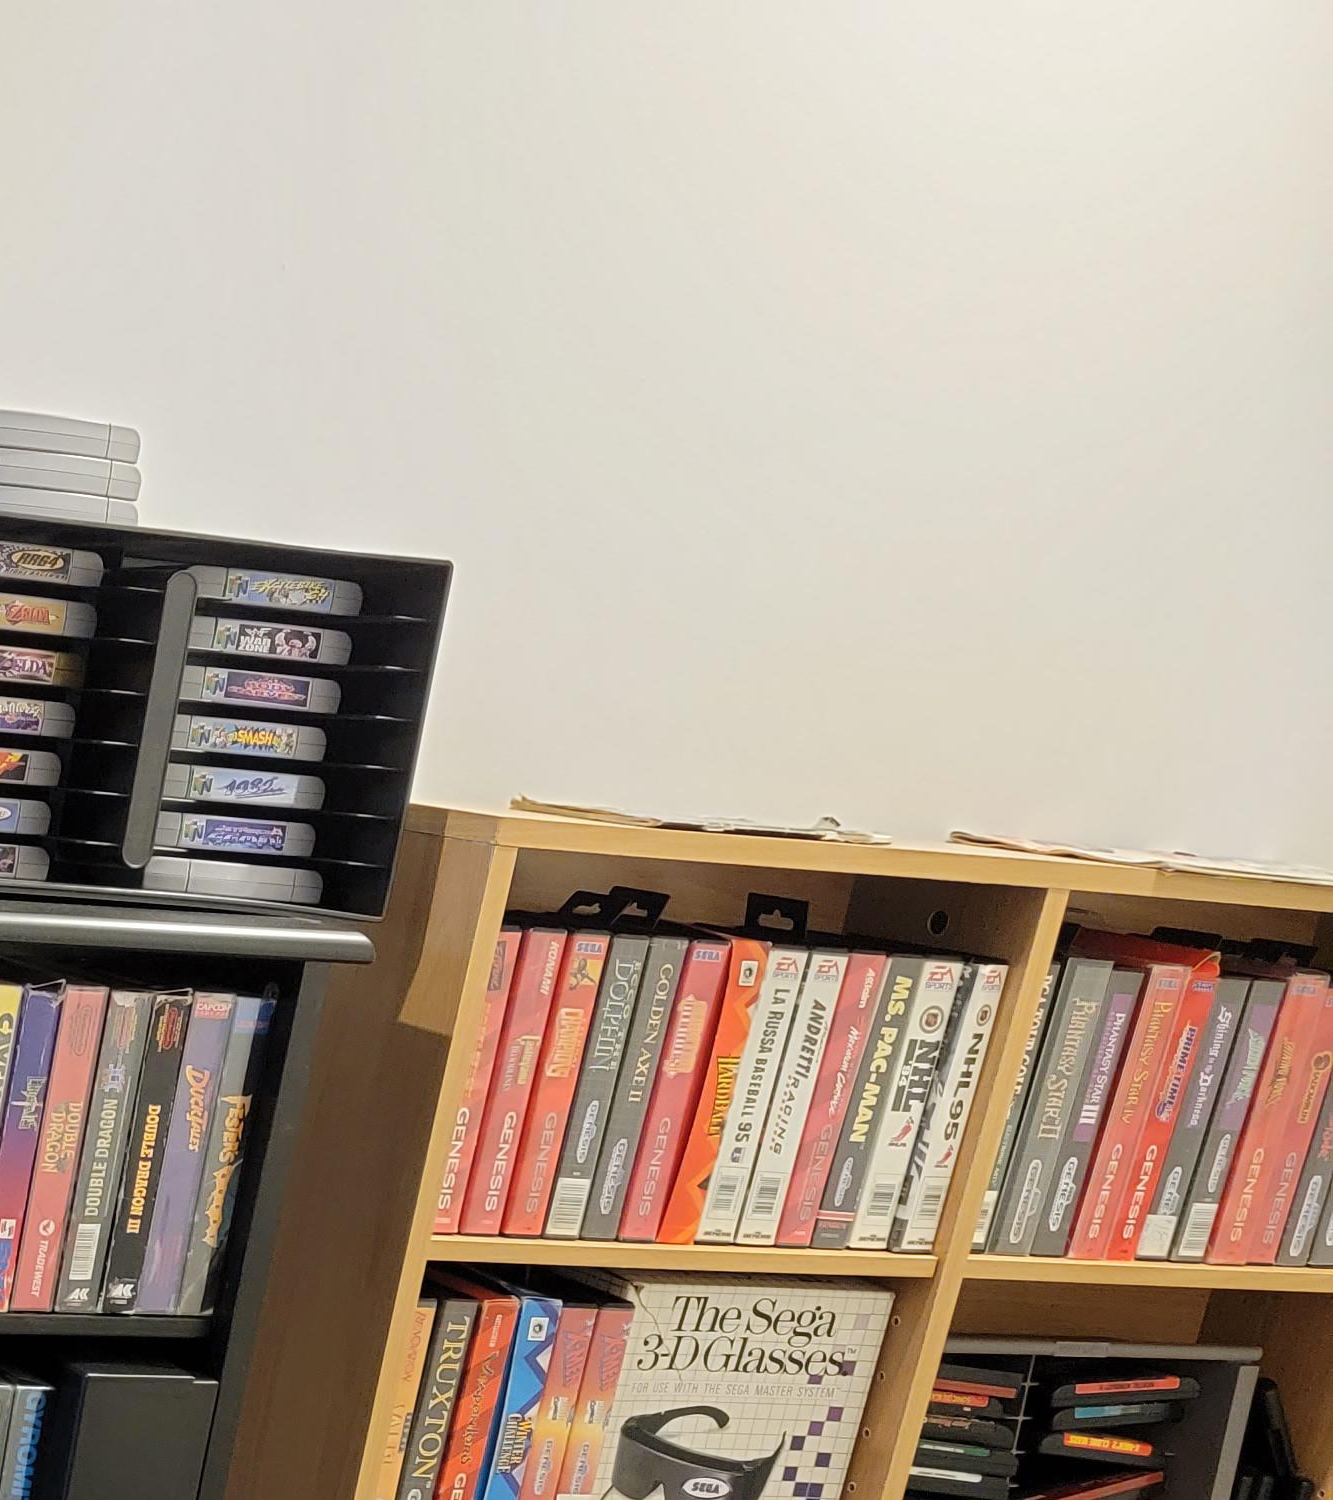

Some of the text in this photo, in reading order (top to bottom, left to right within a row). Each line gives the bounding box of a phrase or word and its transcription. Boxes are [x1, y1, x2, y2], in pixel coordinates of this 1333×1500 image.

[540, 940, 559, 996] KONAMI
[628, 963, 674, 1103] GOLDEN AXE II
[735, 988, 792, 1143] LA RUSSA BASEBALL 95
[796, 999, 828, 1079] ANDRETTI
[849, 975, 913, 1143] MS. PAC-MAN
[84, 1098, 118, 1216] DOUBLE DRAGON
[126, 1104, 161, 1234] DOUBLE DRAGON III
[438, 1107, 470, 1210] GENESIS
[485, 1111, 517, 1212] GENESIS
[637, 1334, 848, 1376] 3-D Glasses
[671, 1295, 837, 1350] The Sega
[417, 1315, 470, 1488] TRUXTON
[631, 1382, 836, 1399] FOR USE WITH THE SEGA MASTER SYSTEM
[495, 1412, 523, 1476] CHALLENGE
[508, 1416, 535, 1468] WINTER
[691, 1481, 722, 1495] SEGA
